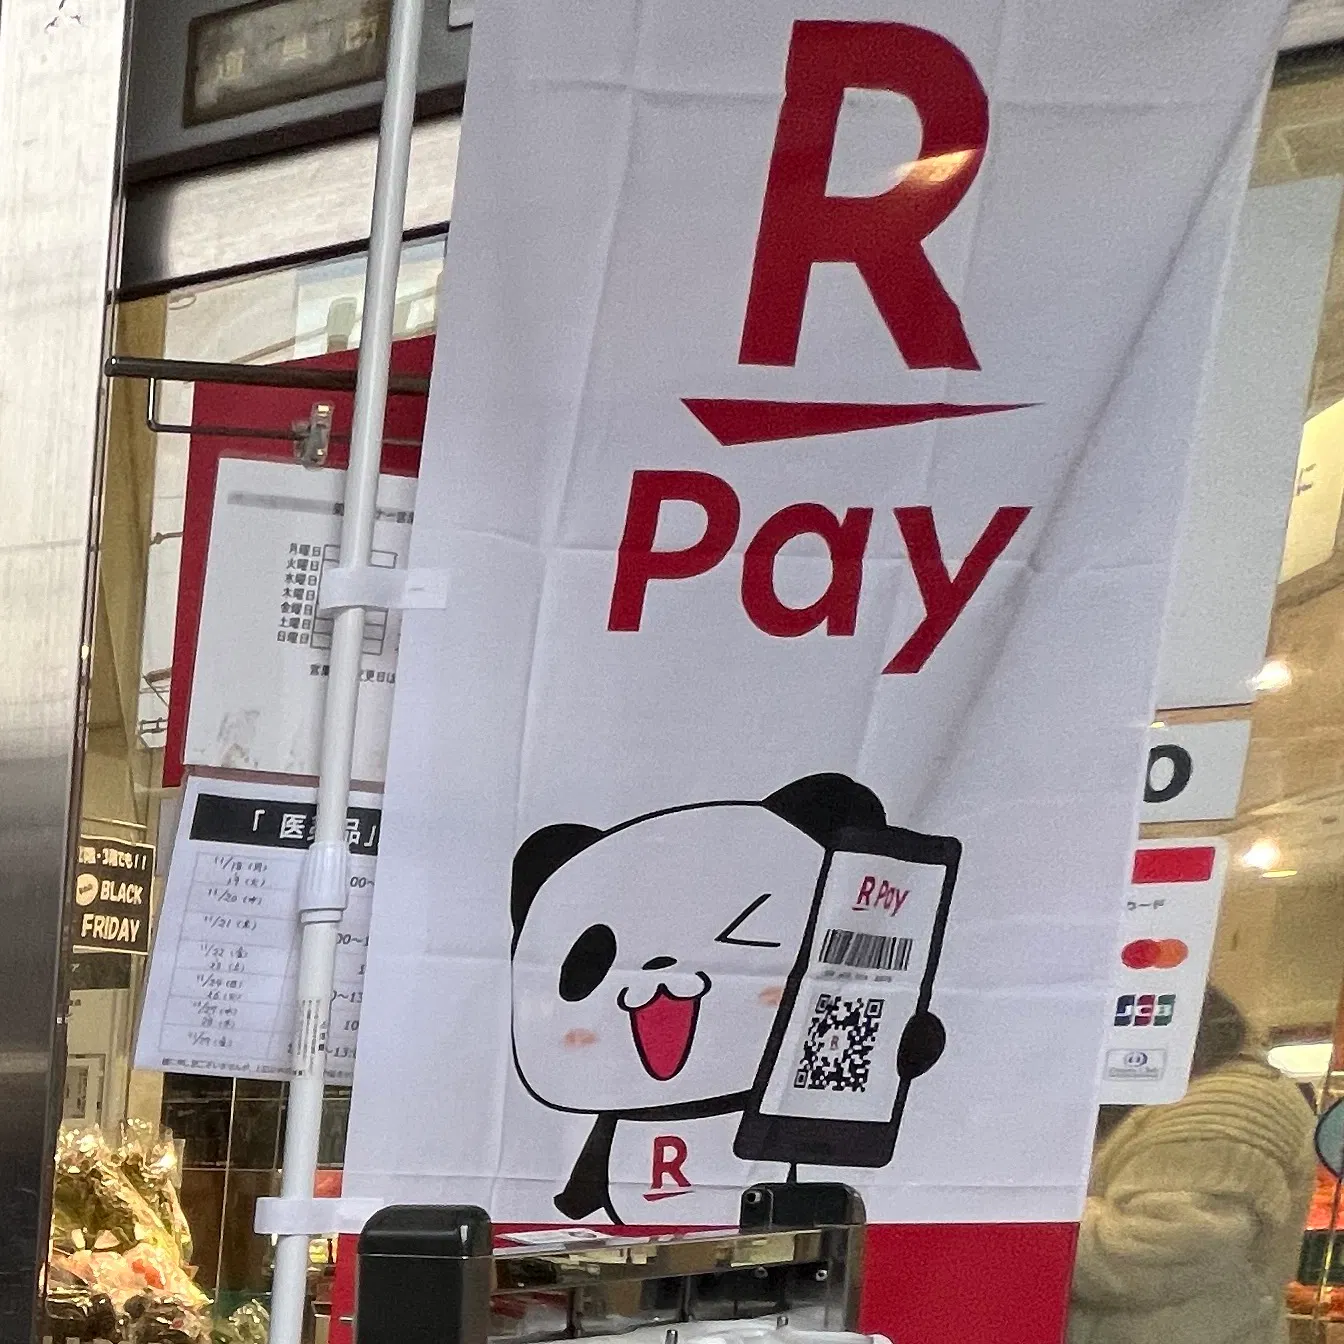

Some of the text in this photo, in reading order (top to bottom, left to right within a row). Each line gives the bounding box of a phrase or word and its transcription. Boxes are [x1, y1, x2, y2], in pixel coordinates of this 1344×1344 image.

[738, 19, 991, 372] R
[607, 469, 1034, 677] Pay
[100, 880, 143, 905] BLACK
[81, 913, 140, 942] FRIDAY
[650, 1135, 692, 1190] R
